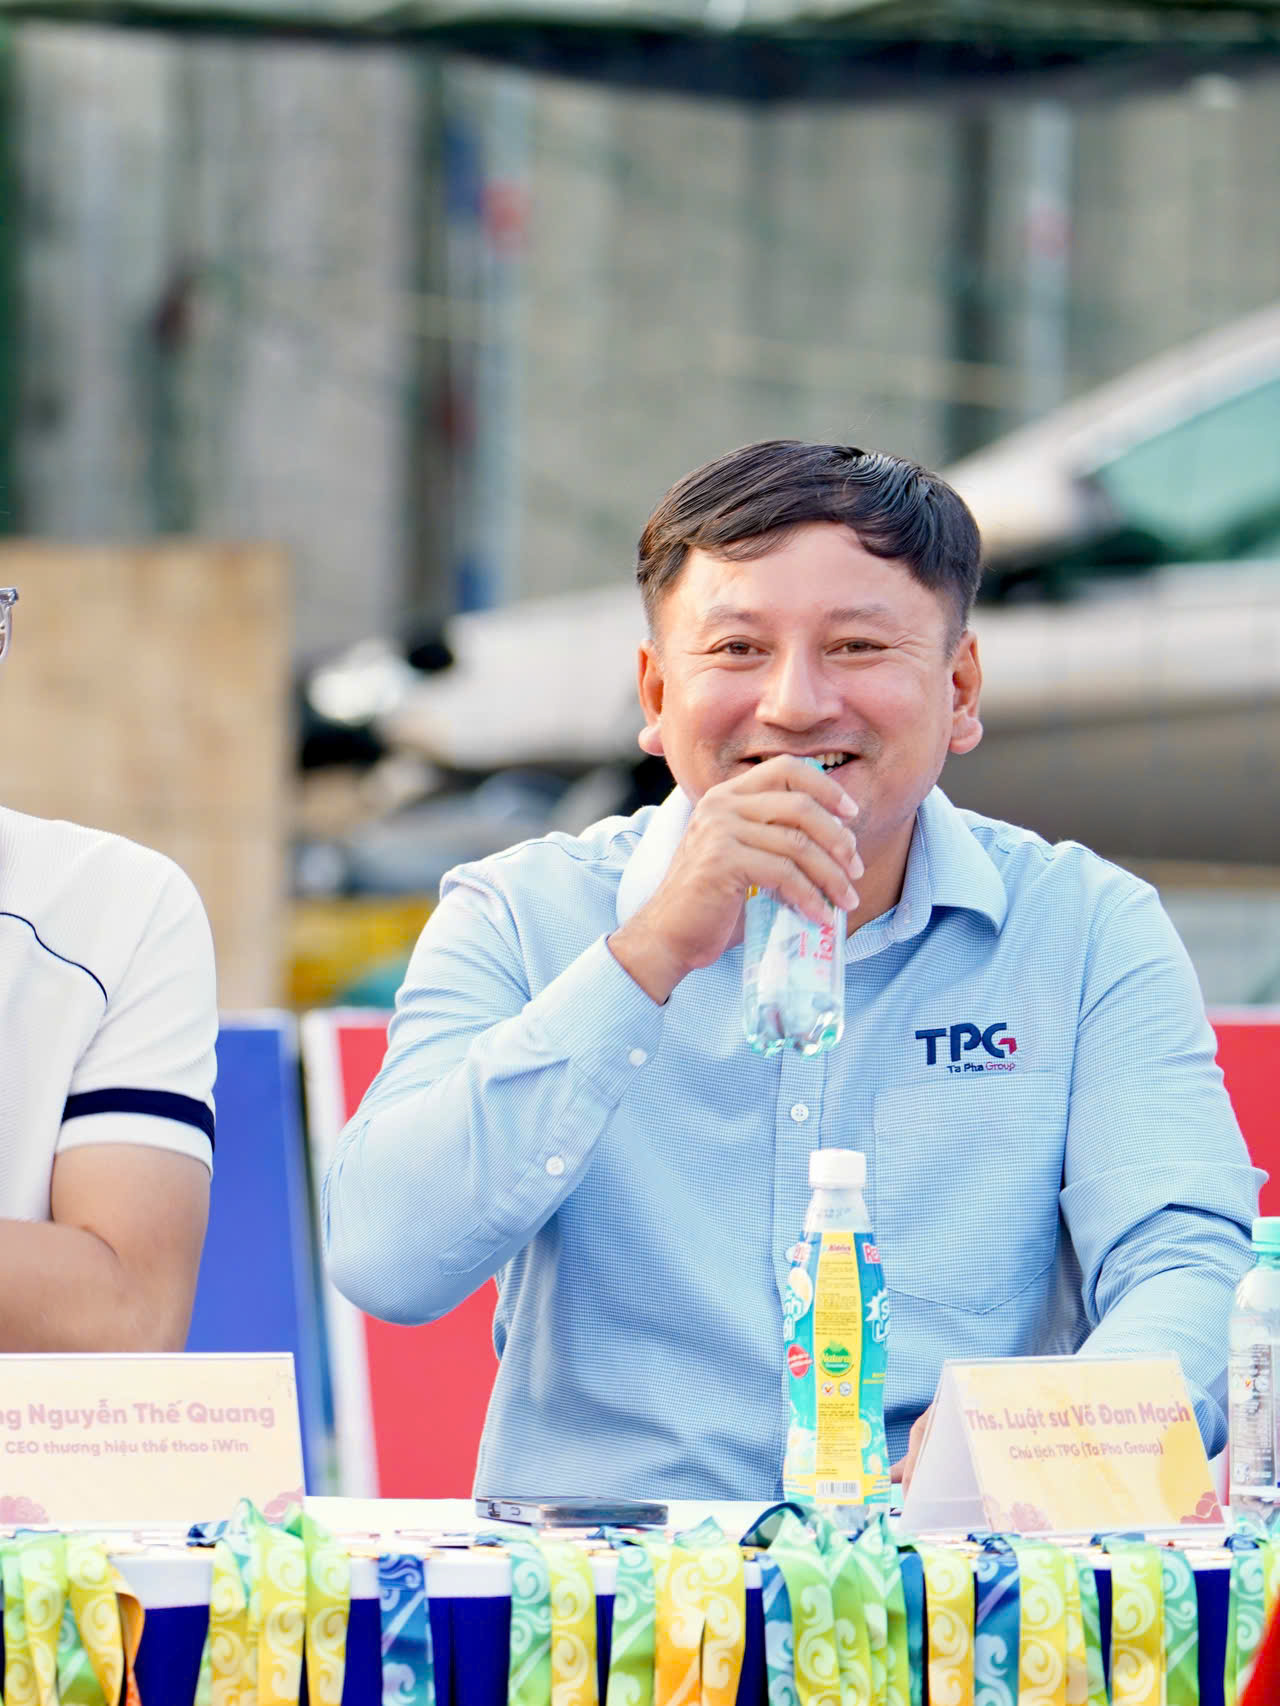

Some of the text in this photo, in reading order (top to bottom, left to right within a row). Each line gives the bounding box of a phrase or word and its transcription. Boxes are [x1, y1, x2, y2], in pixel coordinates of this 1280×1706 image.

[915, 1022, 1017, 1065] TPG
[947, 1061, 1016, 1073] Ta Pha Group
[28, 1398, 128, 1430] Nguyễn
[186, 1402, 275, 1429] Quang
[966, 1407, 1004, 1431] Ths.
[1005, 1406, 1046, 1435] Luật
[1048, 1408, 1071, 1428] sư
[1099, 1403, 1136, 1425] Đan
[1137, 1401, 1192, 1430] Mạch
[5, 1441, 39, 1454] CEO
[172, 1440, 209, 1453] thao
[1056, 1443, 1081, 1457] TPG
[1124, 1438, 1164, 1456] Group)
